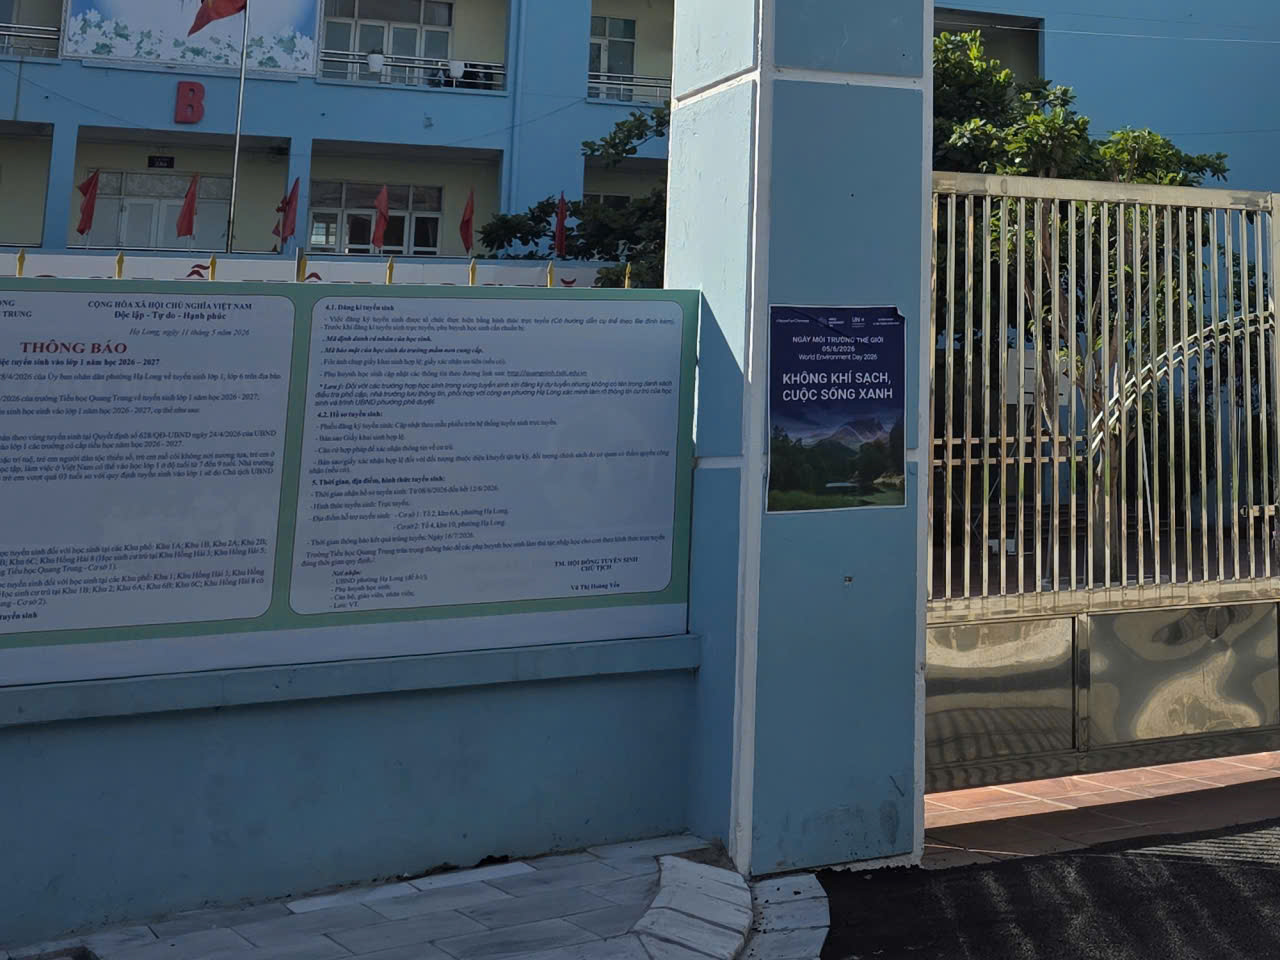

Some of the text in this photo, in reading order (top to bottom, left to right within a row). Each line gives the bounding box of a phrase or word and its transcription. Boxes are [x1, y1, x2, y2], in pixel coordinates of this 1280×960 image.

[175, 81, 205, 124] B
[19, 339, 128, 354] THÔNG BÁO
[782, 369, 891, 386] KHÔNG KHÍ SẠCH,
[782, 385, 893, 403] CUỘC SỐNG XANH
